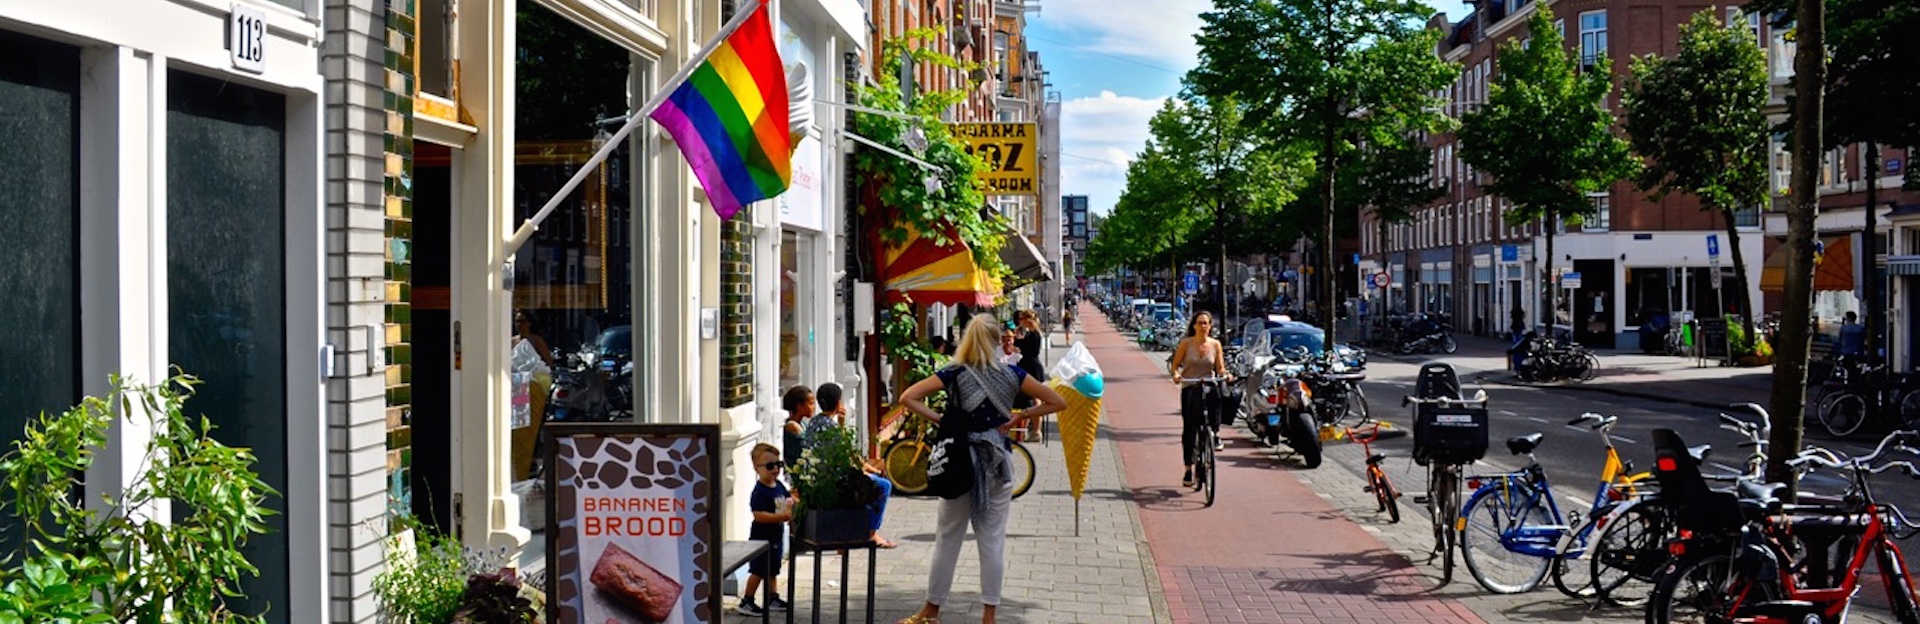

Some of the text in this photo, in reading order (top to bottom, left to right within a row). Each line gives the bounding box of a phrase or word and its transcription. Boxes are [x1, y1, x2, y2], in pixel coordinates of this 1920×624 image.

[237, 14, 263, 62] 113
[583, 497, 686, 512] BANANEN
[584, 517, 687, 536] BROOD
